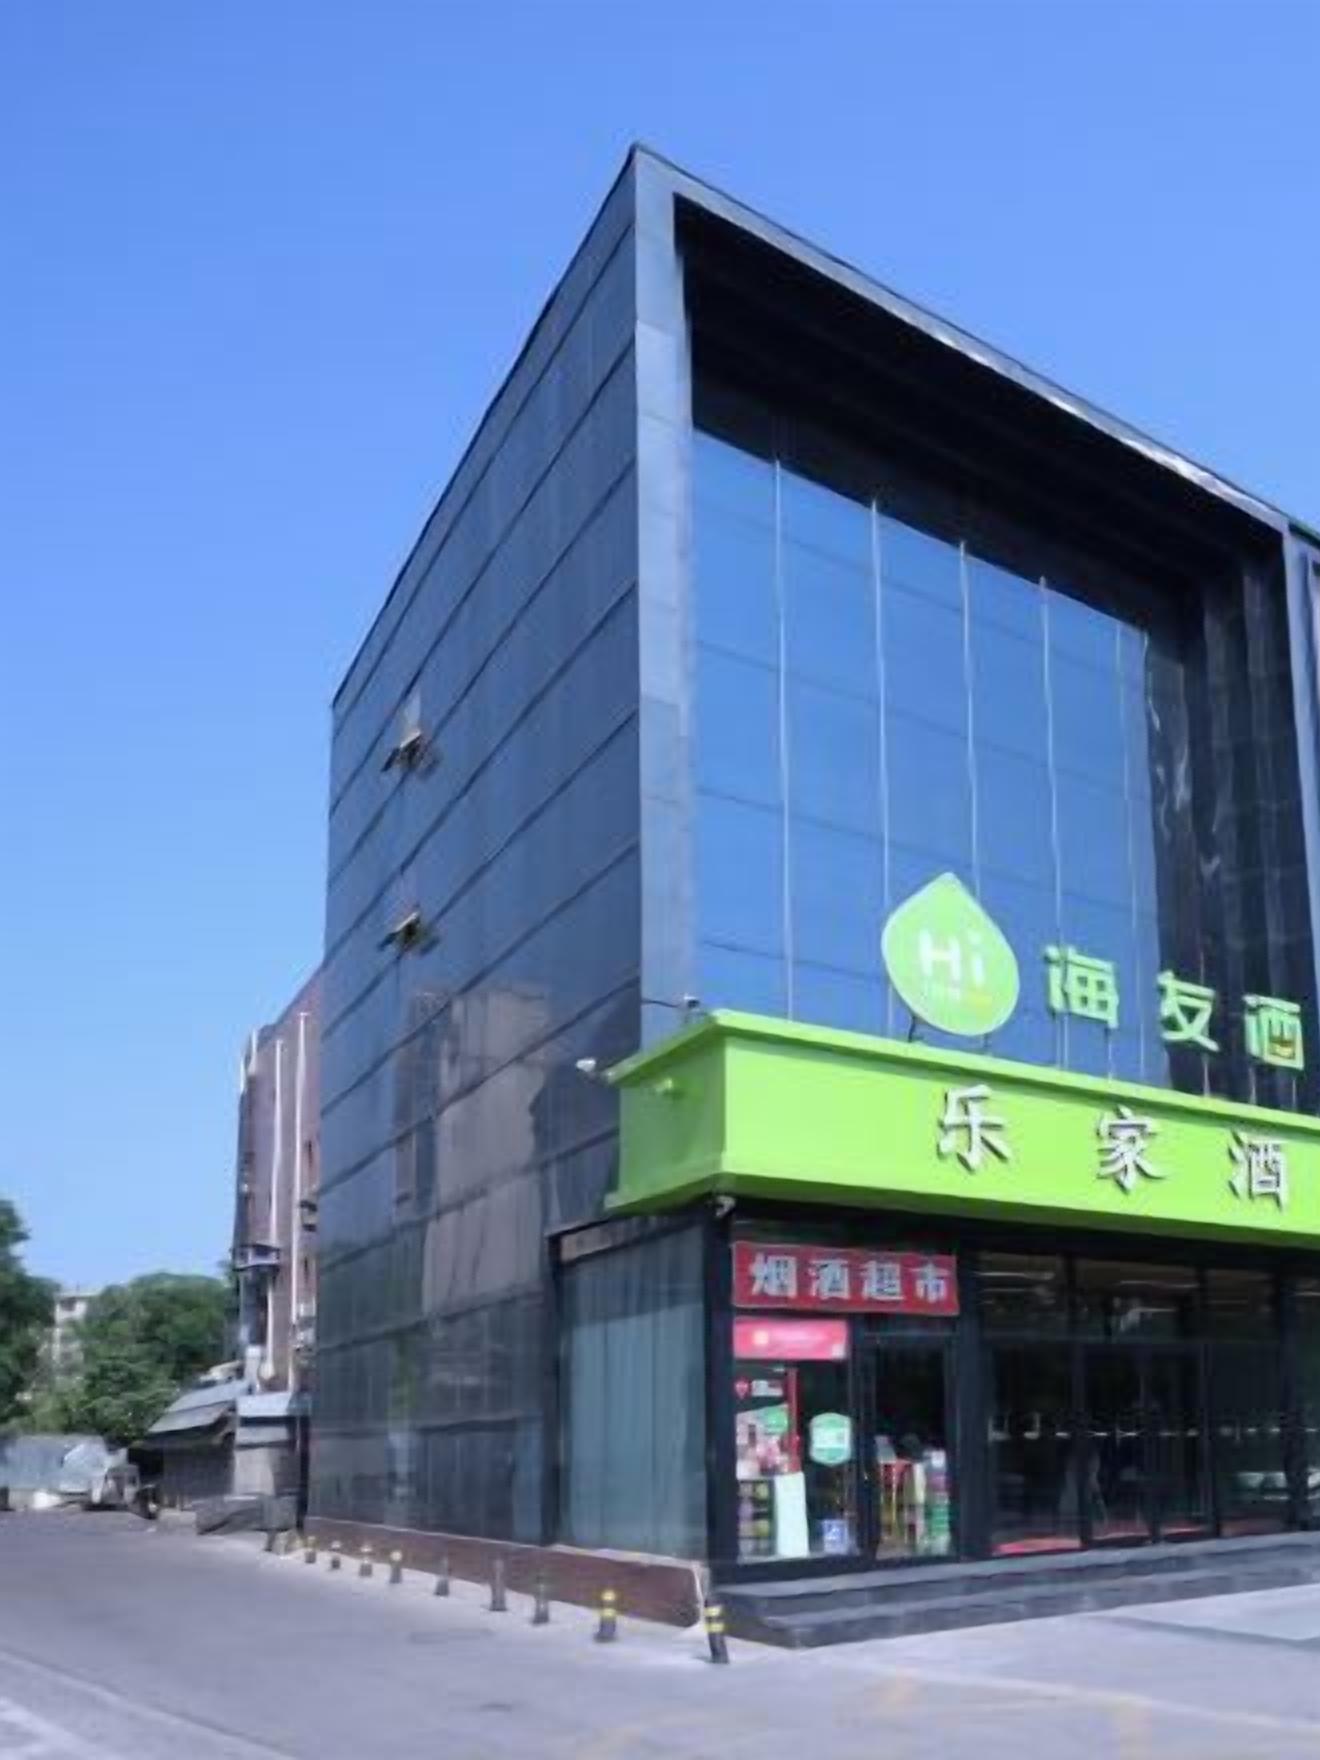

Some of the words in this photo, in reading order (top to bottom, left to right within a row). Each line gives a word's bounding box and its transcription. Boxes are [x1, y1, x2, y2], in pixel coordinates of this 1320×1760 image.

[918, 929, 986, 988] Hi
[751, 1253, 949, 1304] 烟酒超市
